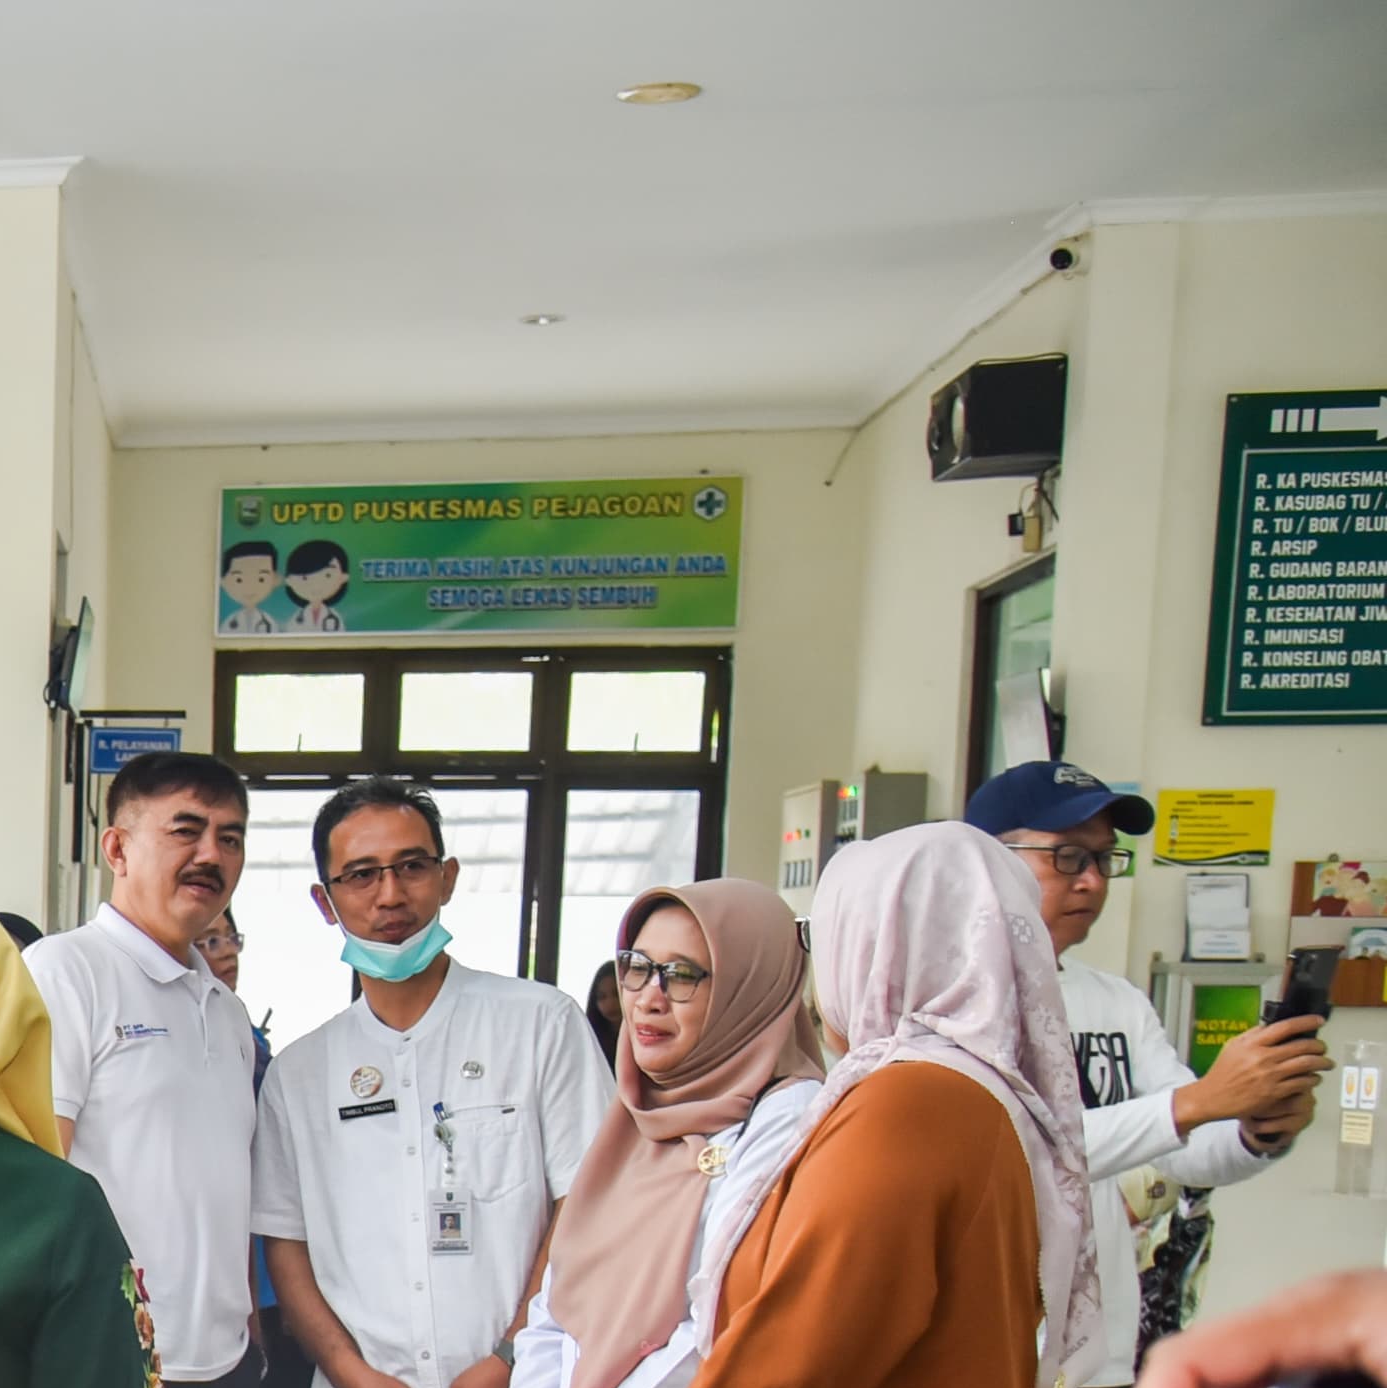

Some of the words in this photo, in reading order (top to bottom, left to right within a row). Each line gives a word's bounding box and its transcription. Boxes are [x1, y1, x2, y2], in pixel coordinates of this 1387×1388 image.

[1256, 473, 1272, 489] R.
[1277, 472, 1296, 488] KA
[1301, 471, 1387, 488] PUSKESMA
[271, 502, 344, 524] UPTD
[352, 498, 523, 523] PUSKESMAS
[532, 494, 684, 518] PEJAGOAN
[1254, 495, 1270, 511] R.
[1275, 494, 1346, 511] KASUBAG
[1350, 493, 1371, 509] TU
[1252, 517, 1268, 534] R.
[1273, 517, 1294, 533] TU
[1309, 516, 1339, 533] BOK
[1355, 515, 1387, 532] BLU
[1251, 540, 1267, 557] R.
[1271, 540, 1318, 556] ARSIP
[363, 560, 431, 579] TERIMA
[436, 558, 494, 578] KASIH
[498, 557, 545, 577] ATAS
[549, 556, 669, 576] KUNJUNGAN
[674, 554, 727, 574] ANDA
[1249, 562, 1265, 579] R.
[1270, 562, 1332, 578] GUDANG
[1336, 560, 1387, 577] BARAN
[428, 587, 506, 608] SEMOGA
[511, 586, 573, 607] LEKAS
[578, 585, 658, 607] SEMBUH
[1247, 585, 1263, 601] R.
[1268, 583, 1385, 601] LABORATORIUM
[1245, 607, 1261, 624] R.
[1266, 605, 1355, 622] KESEHATAN
[1359, 605, 1387, 621] JIW
[1244, 629, 1259, 645] R.
[1264, 628, 1344, 645] IMUNISASI
[1242, 651, 1258, 668] R.
[1263, 650, 1347, 667] KONSELING
[1240, 673, 1256, 690] R.
[1261, 672, 1350, 689] AKREDITASI
